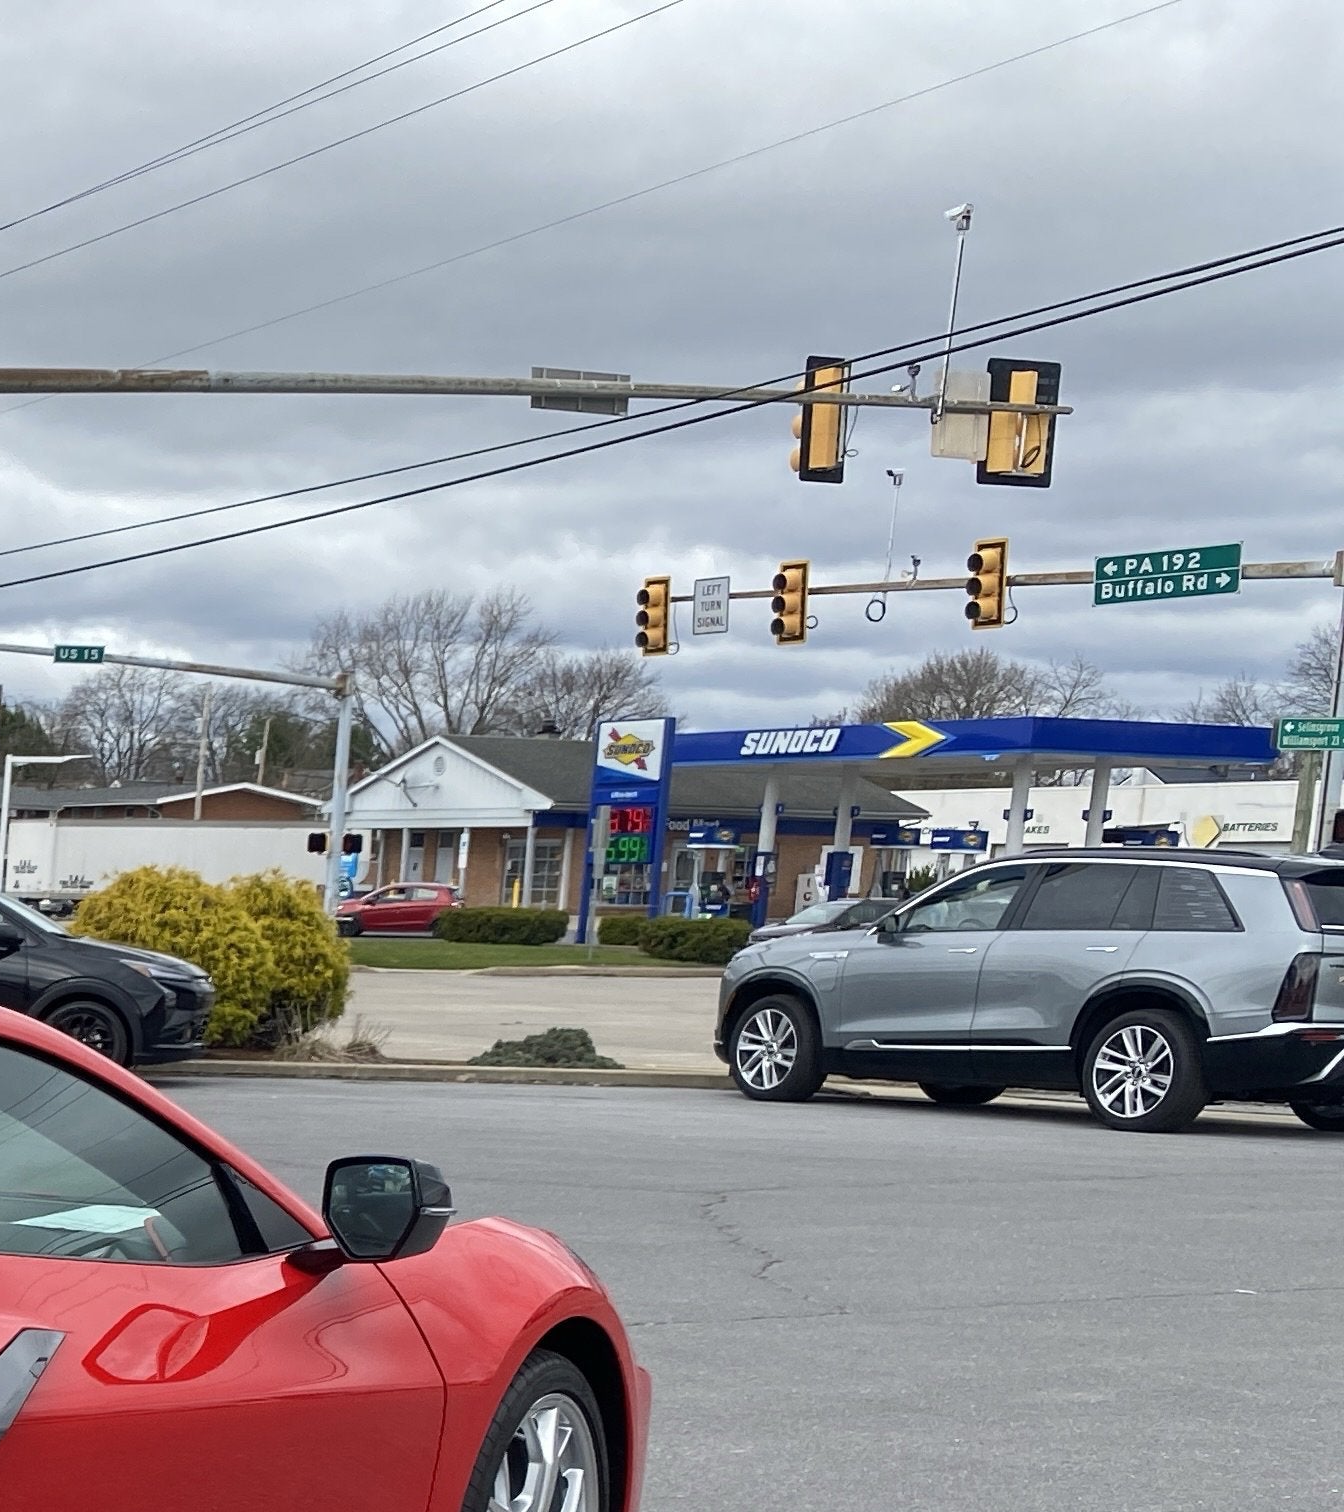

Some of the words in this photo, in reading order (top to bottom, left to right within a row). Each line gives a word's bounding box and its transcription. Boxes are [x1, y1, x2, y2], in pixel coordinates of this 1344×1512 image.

[1124, 556, 1153, 576] PA
[1162, 552, 1201, 572] 192
[702, 583, 722, 597] LEFT
[1100, 577, 1175, 600] Buffalo
[1182, 573, 1208, 592] Rd
[700, 600, 722, 611] TURN
[696, 615, 726, 628] SIGNAL
[59, 648, 79, 660] US
[83, 648, 99, 660] 15
[606, 742, 651, 756] SUNOCO
[740, 728, 841, 756] SUNOCO
[1222, 822, 1279, 833] BATTERIES
